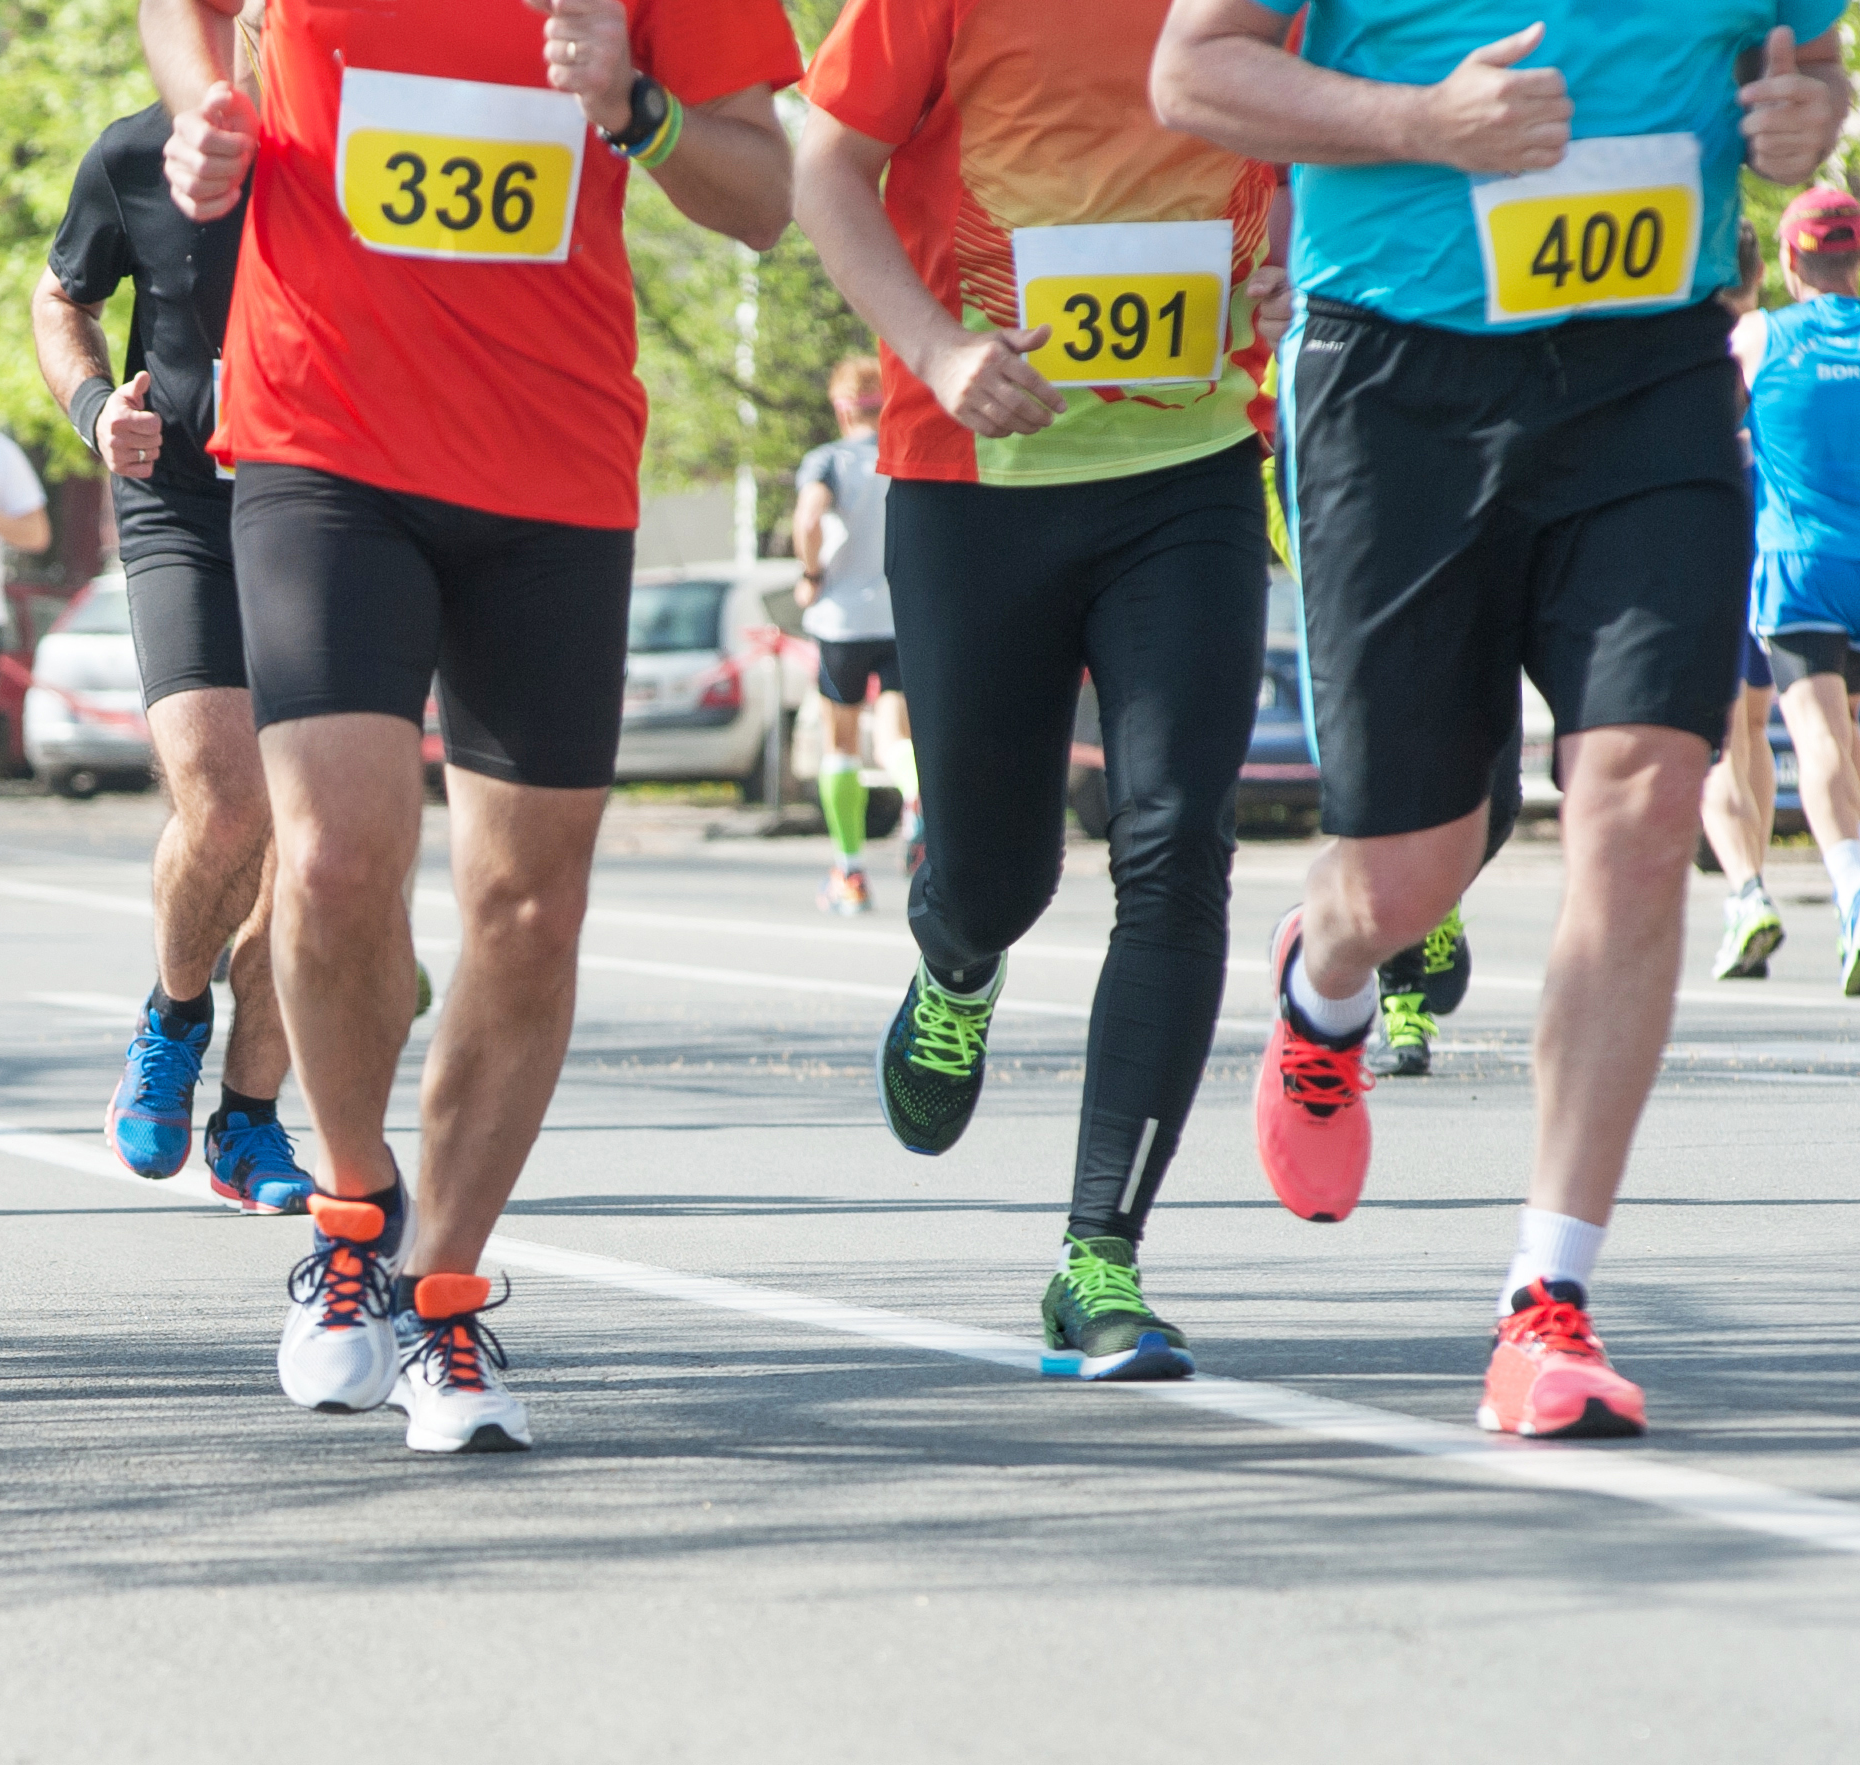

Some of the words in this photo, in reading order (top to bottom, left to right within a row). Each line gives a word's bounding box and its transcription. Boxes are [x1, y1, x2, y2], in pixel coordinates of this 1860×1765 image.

[381, 151, 536, 233] 336
[1532, 207, 1665, 287] 400
[1064, 291, 1187, 361] 391
